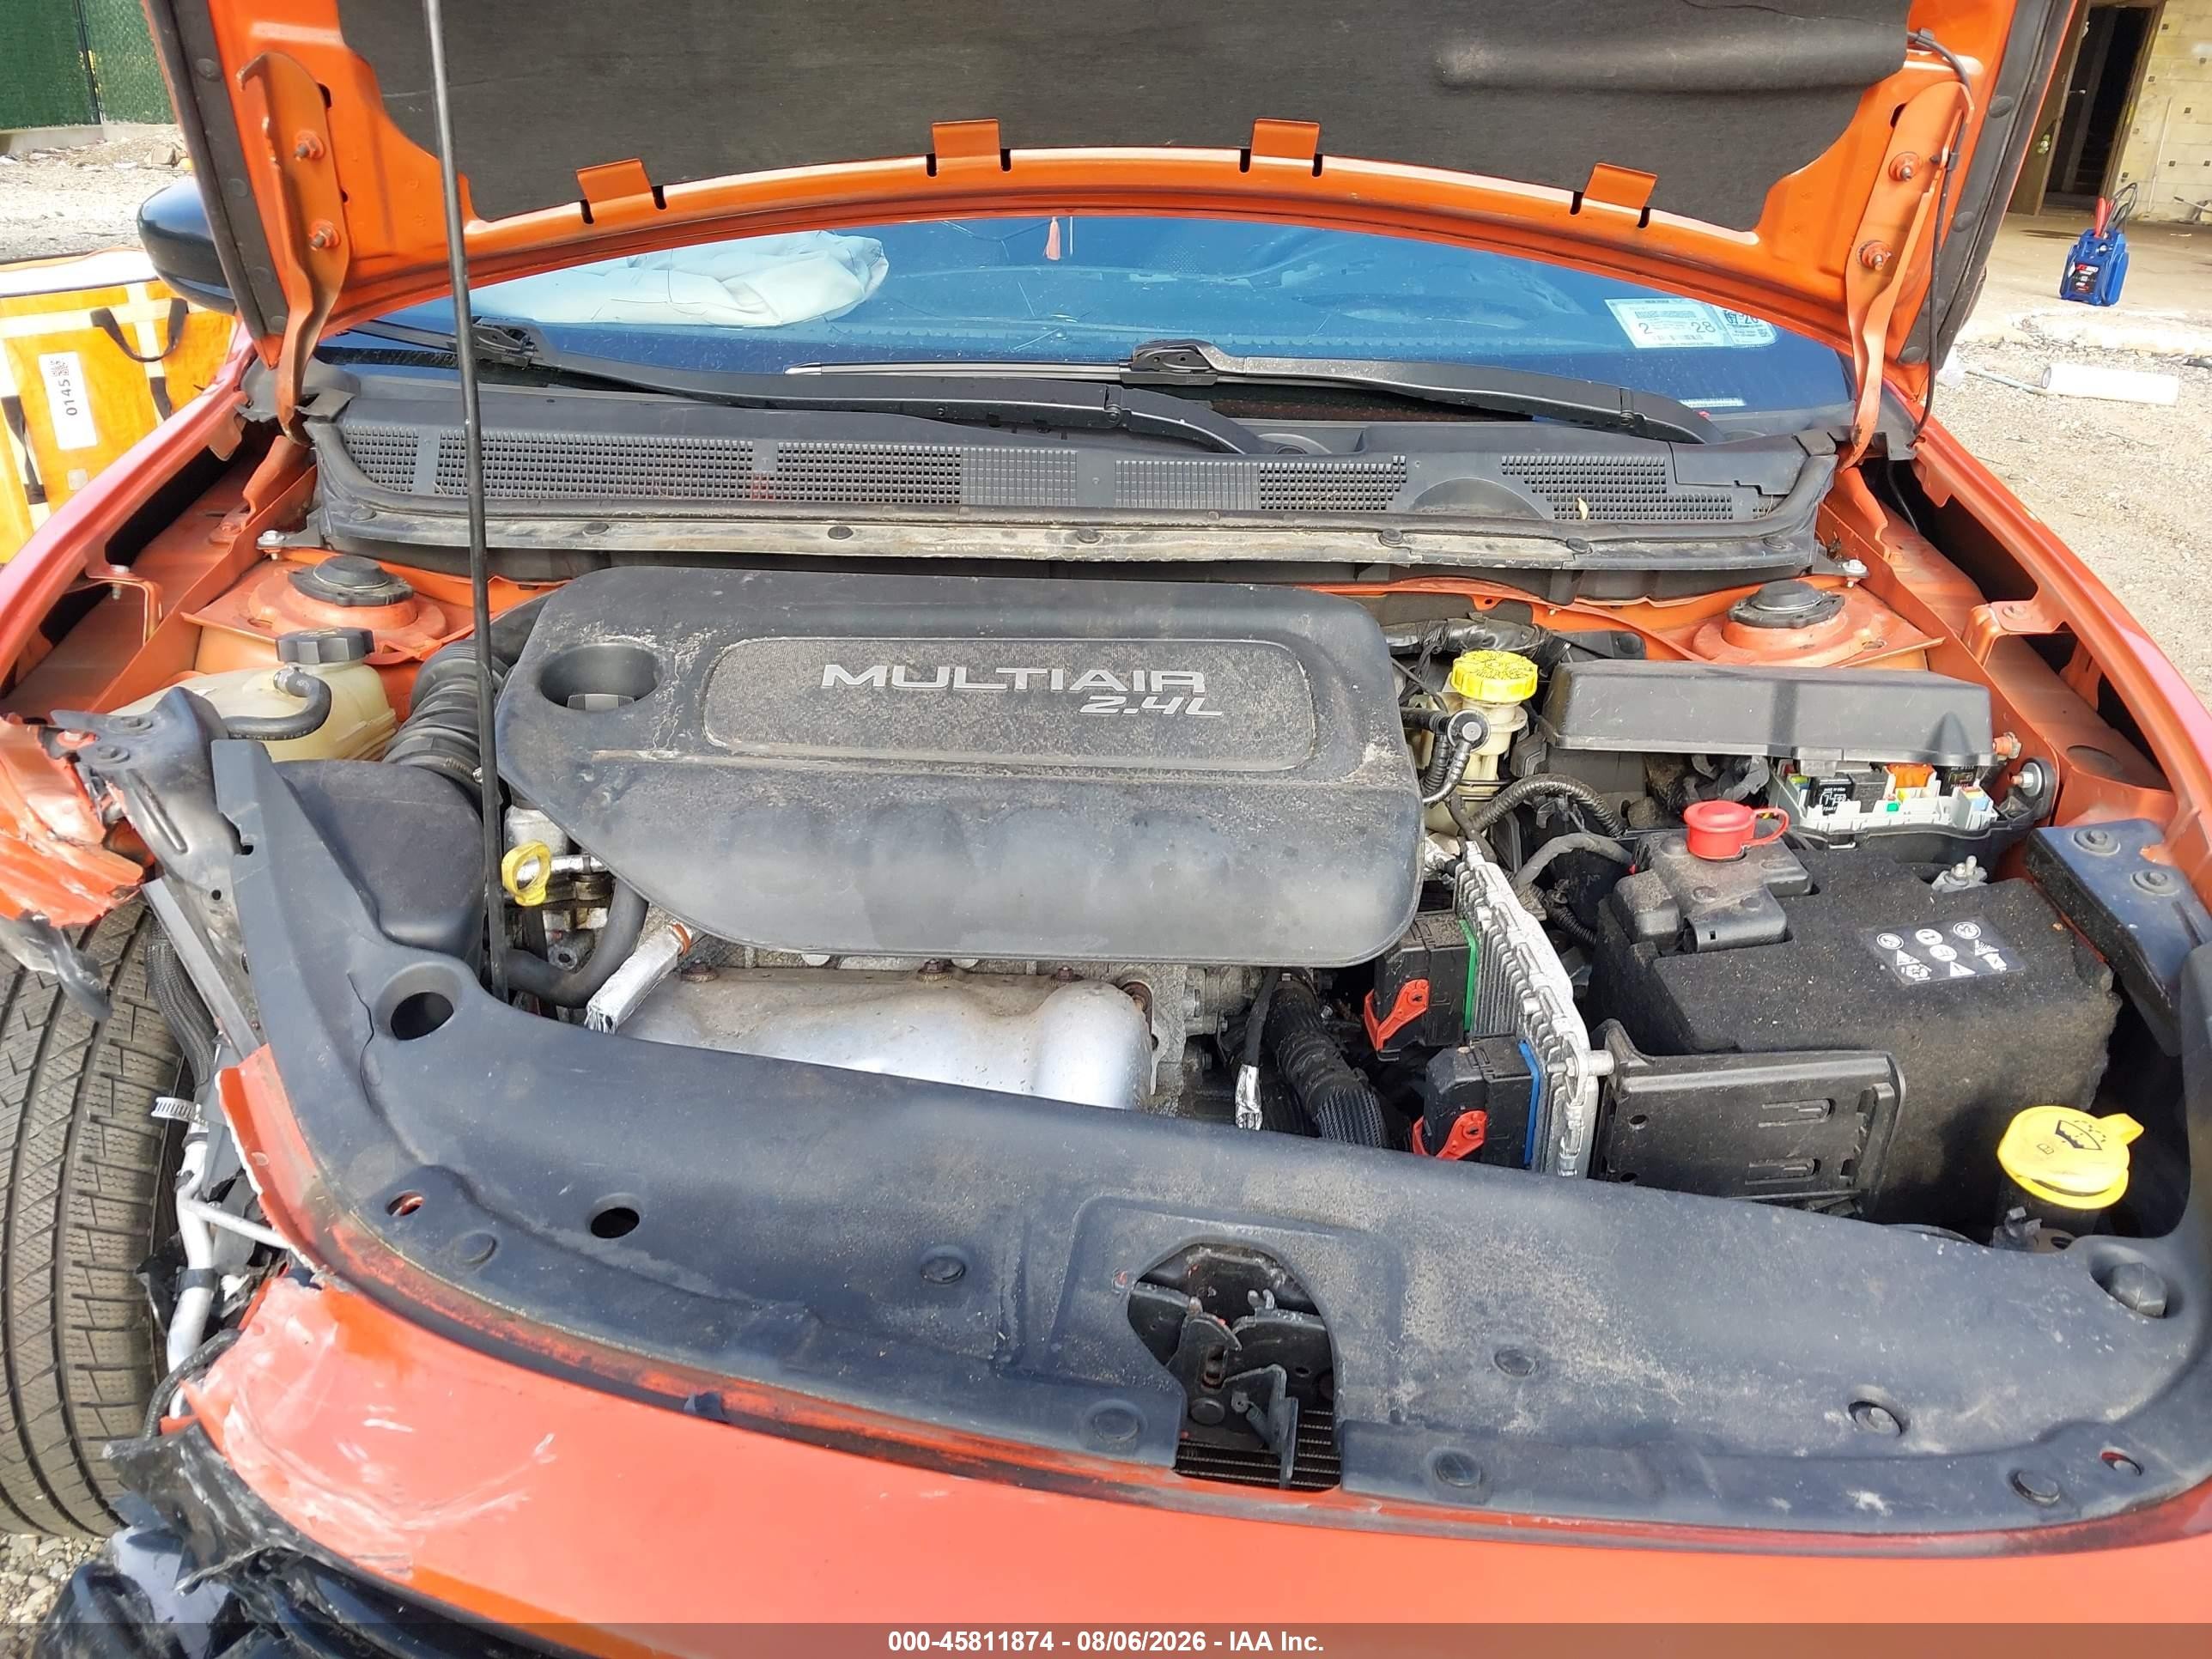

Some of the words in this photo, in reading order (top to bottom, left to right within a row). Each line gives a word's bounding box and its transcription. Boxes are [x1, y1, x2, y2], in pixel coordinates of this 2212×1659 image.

[1638, 322, 1654, 335] 2
[1691, 321, 1716, 333] 28
[58, 378, 78, 416] 0145
[821, 664, 1206, 693] MULTIAIR
[1079, 696, 1224, 716] 2.4L
